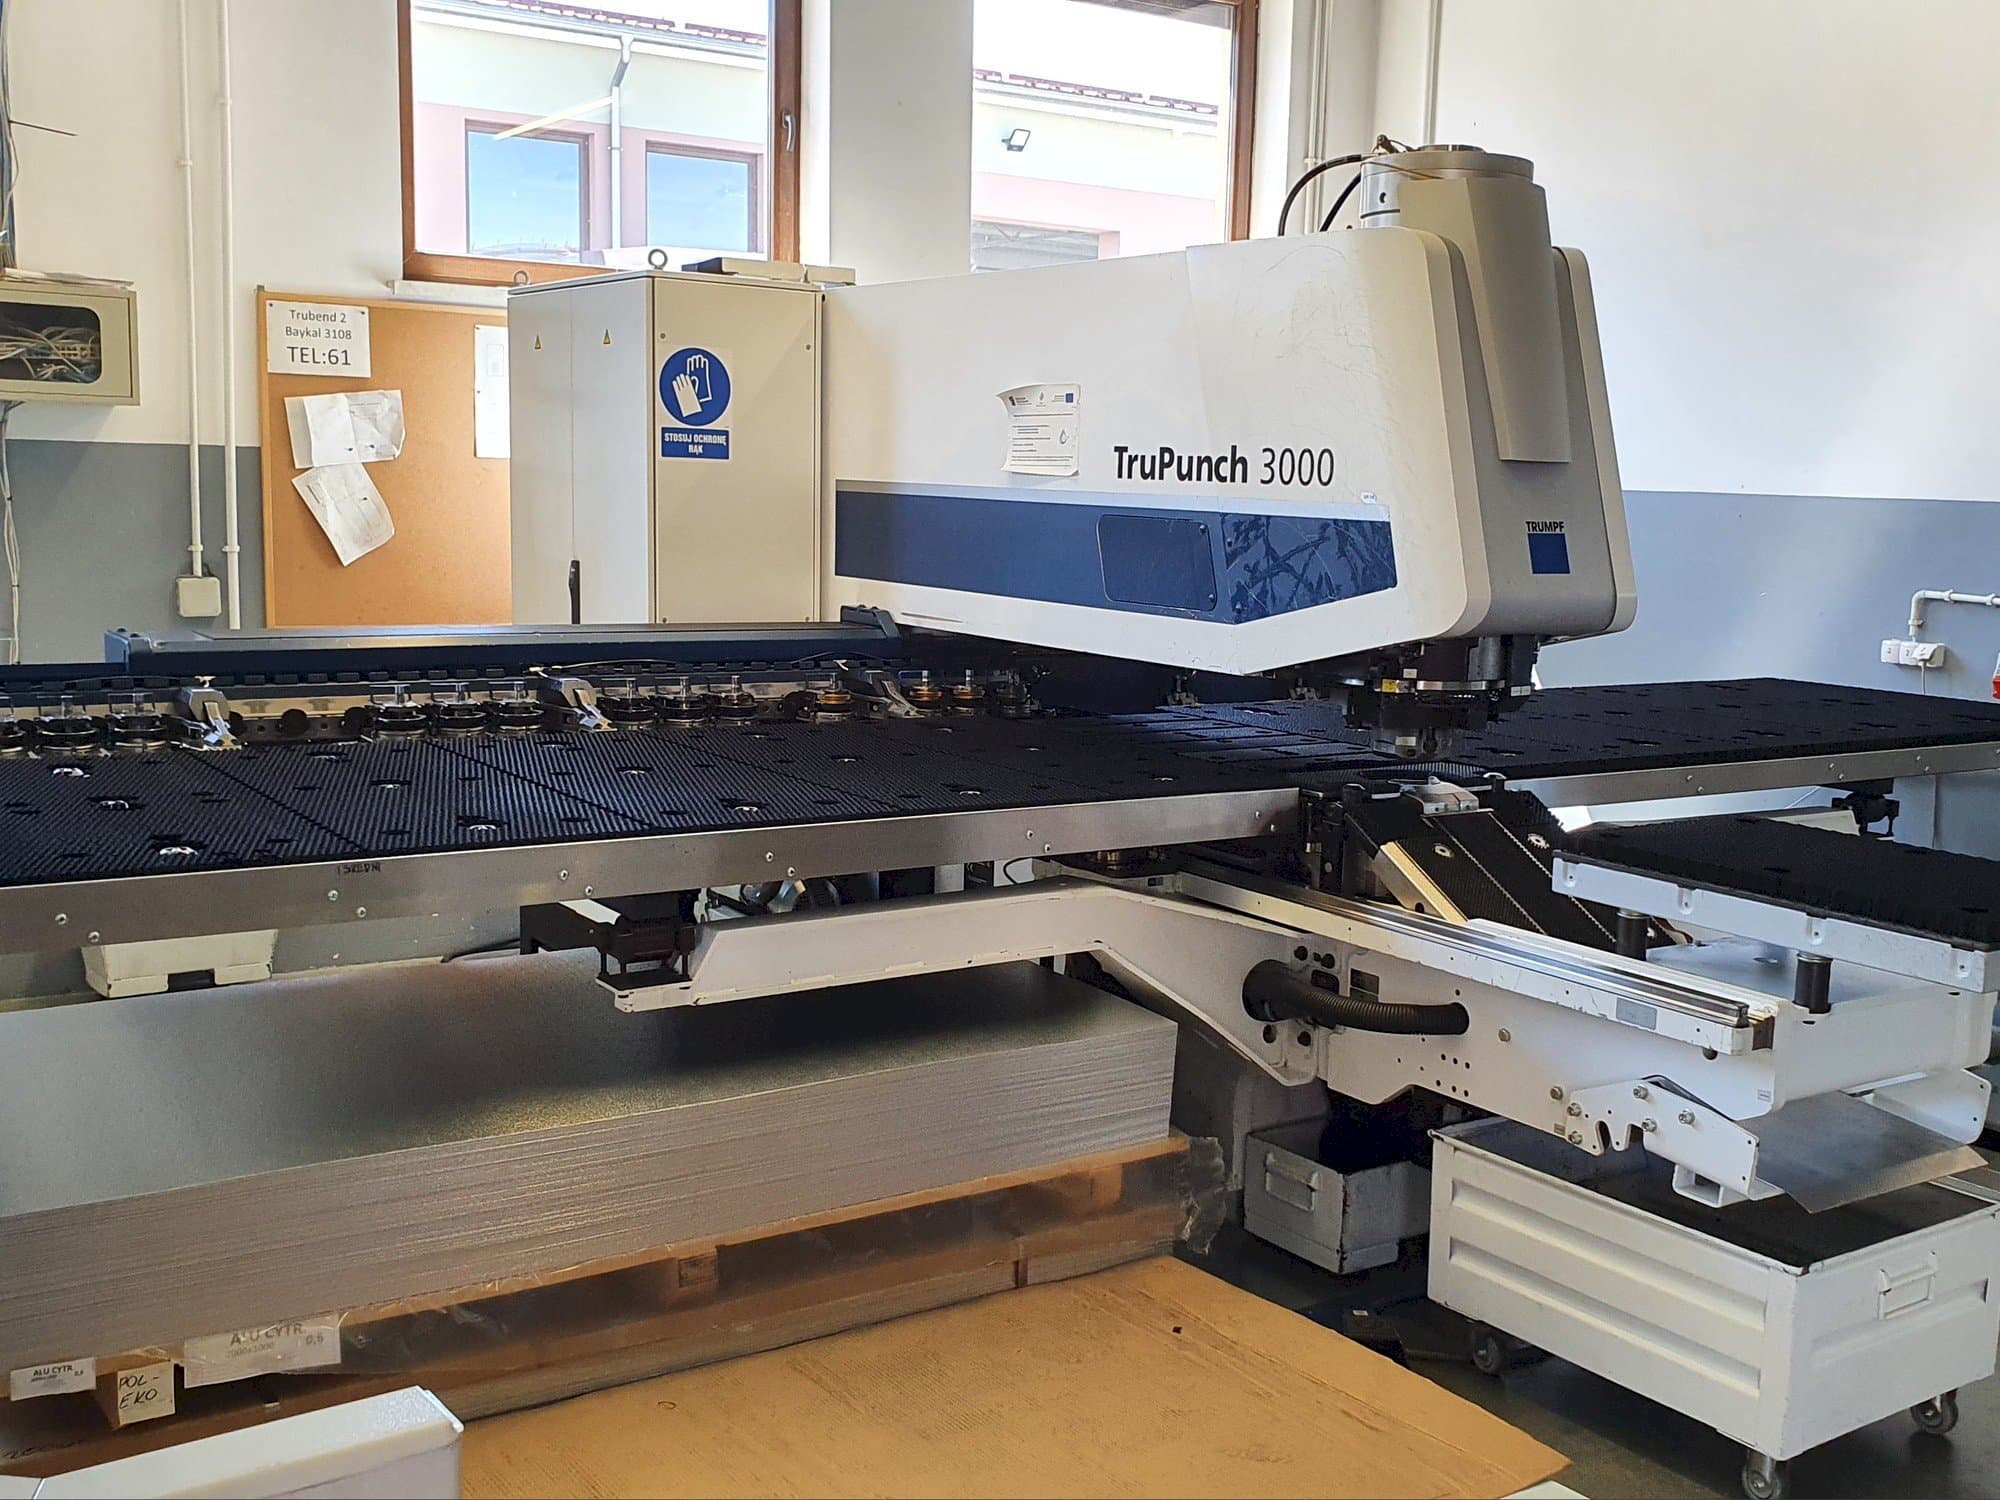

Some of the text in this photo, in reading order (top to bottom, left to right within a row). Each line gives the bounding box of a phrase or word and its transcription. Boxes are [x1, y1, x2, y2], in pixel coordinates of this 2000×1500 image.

[289, 309, 347, 323] Trubend 2
[285, 326, 352, 340] Baykal 3108
[286, 346, 352, 366] TEL:61
[664, 432, 727, 446] STOSUJ OCHRONĘ
[688, 444, 703, 456] RĄK
[1113, 444, 1335, 487] TruPunch 3000
[1525, 520, 1565, 533] TRUMPF
[33, 1368, 50, 1377] ALU
[119, 1388, 158, 1409] EKO
